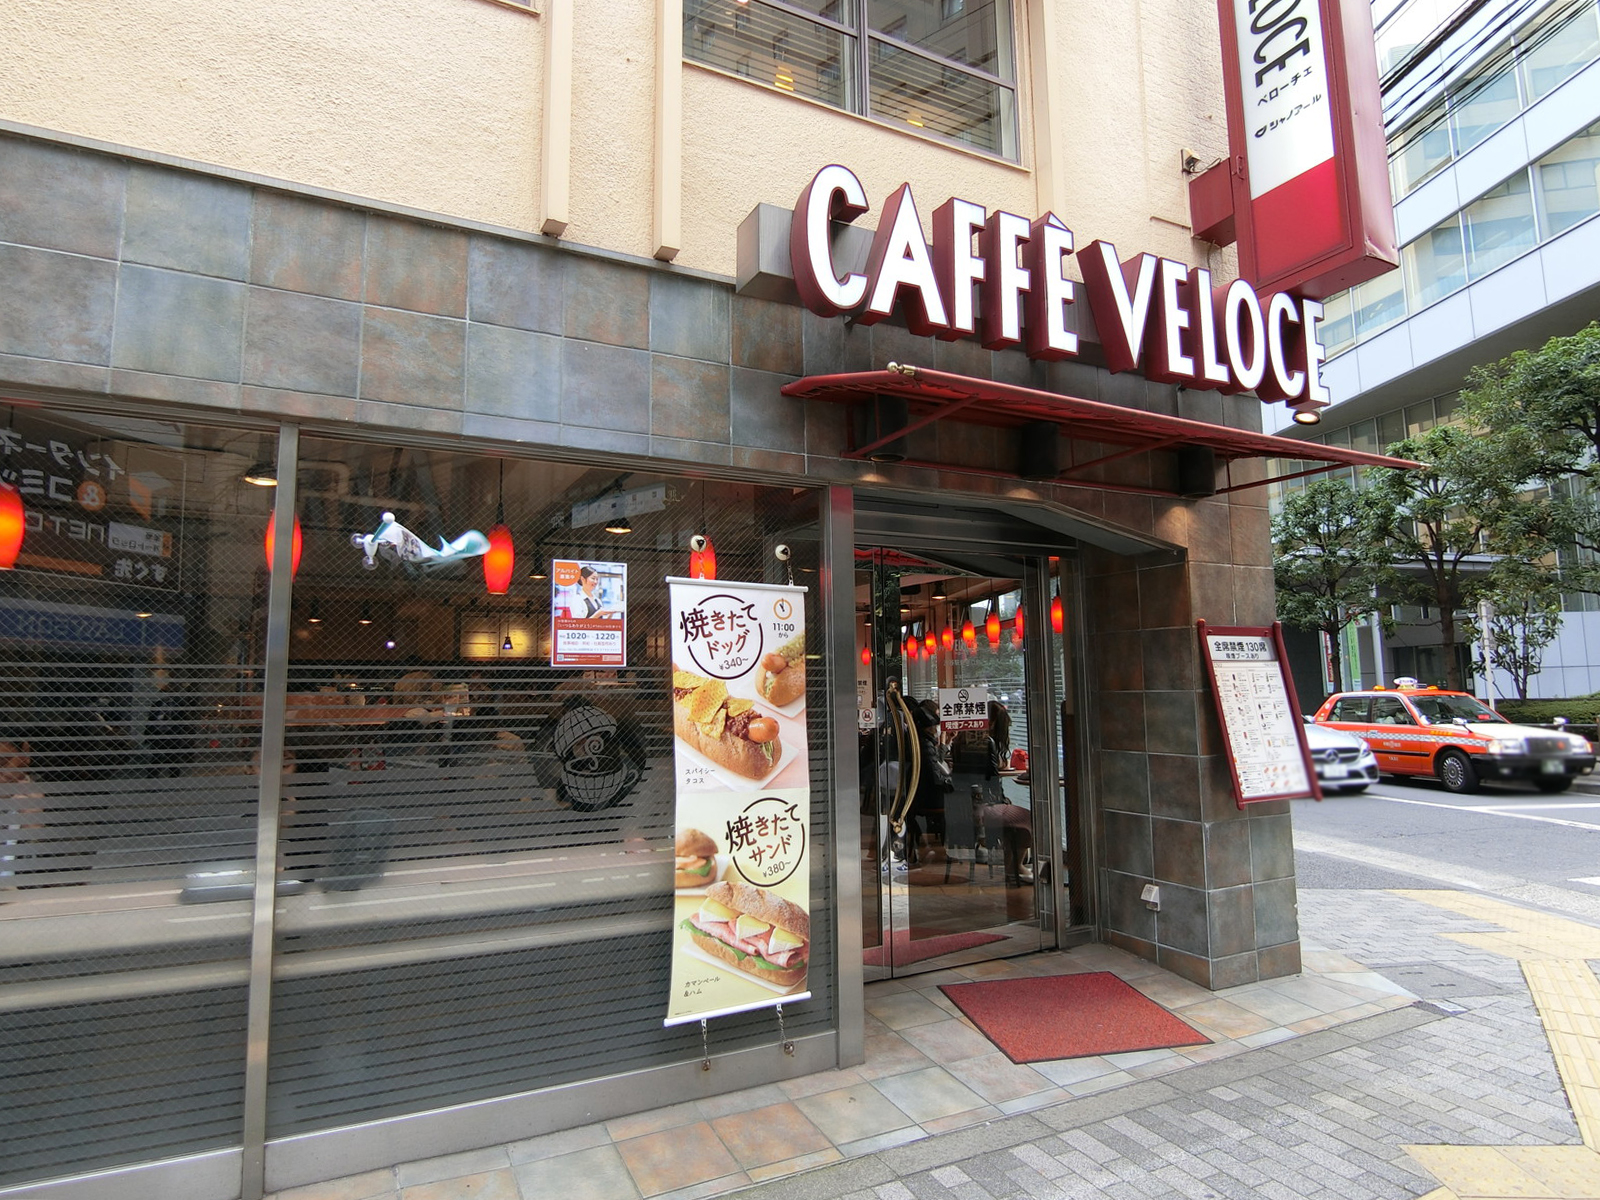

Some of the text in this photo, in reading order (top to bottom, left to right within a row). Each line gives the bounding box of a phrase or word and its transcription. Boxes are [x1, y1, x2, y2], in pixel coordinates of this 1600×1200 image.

[1249, 0, 1311, 88] OCE
[1077, 239, 1331, 409] VELOCE
[679, 603, 758, 643] 焼きたて
[772, 622, 795, 632] 11:00
[566, 632, 587, 640] 1020
[778, 631, 789, 639] から
[706, 629, 750, 660] ドッグ
[942, 701, 986, 717] 全席禁煙
[685, 766, 716, 775] スパイシー
[686, 777, 705, 785] タコス
[725, 803, 801, 854] 焼きたて
[748, 833, 792, 867] サンド
[685, 975, 721, 988] カマンベール
